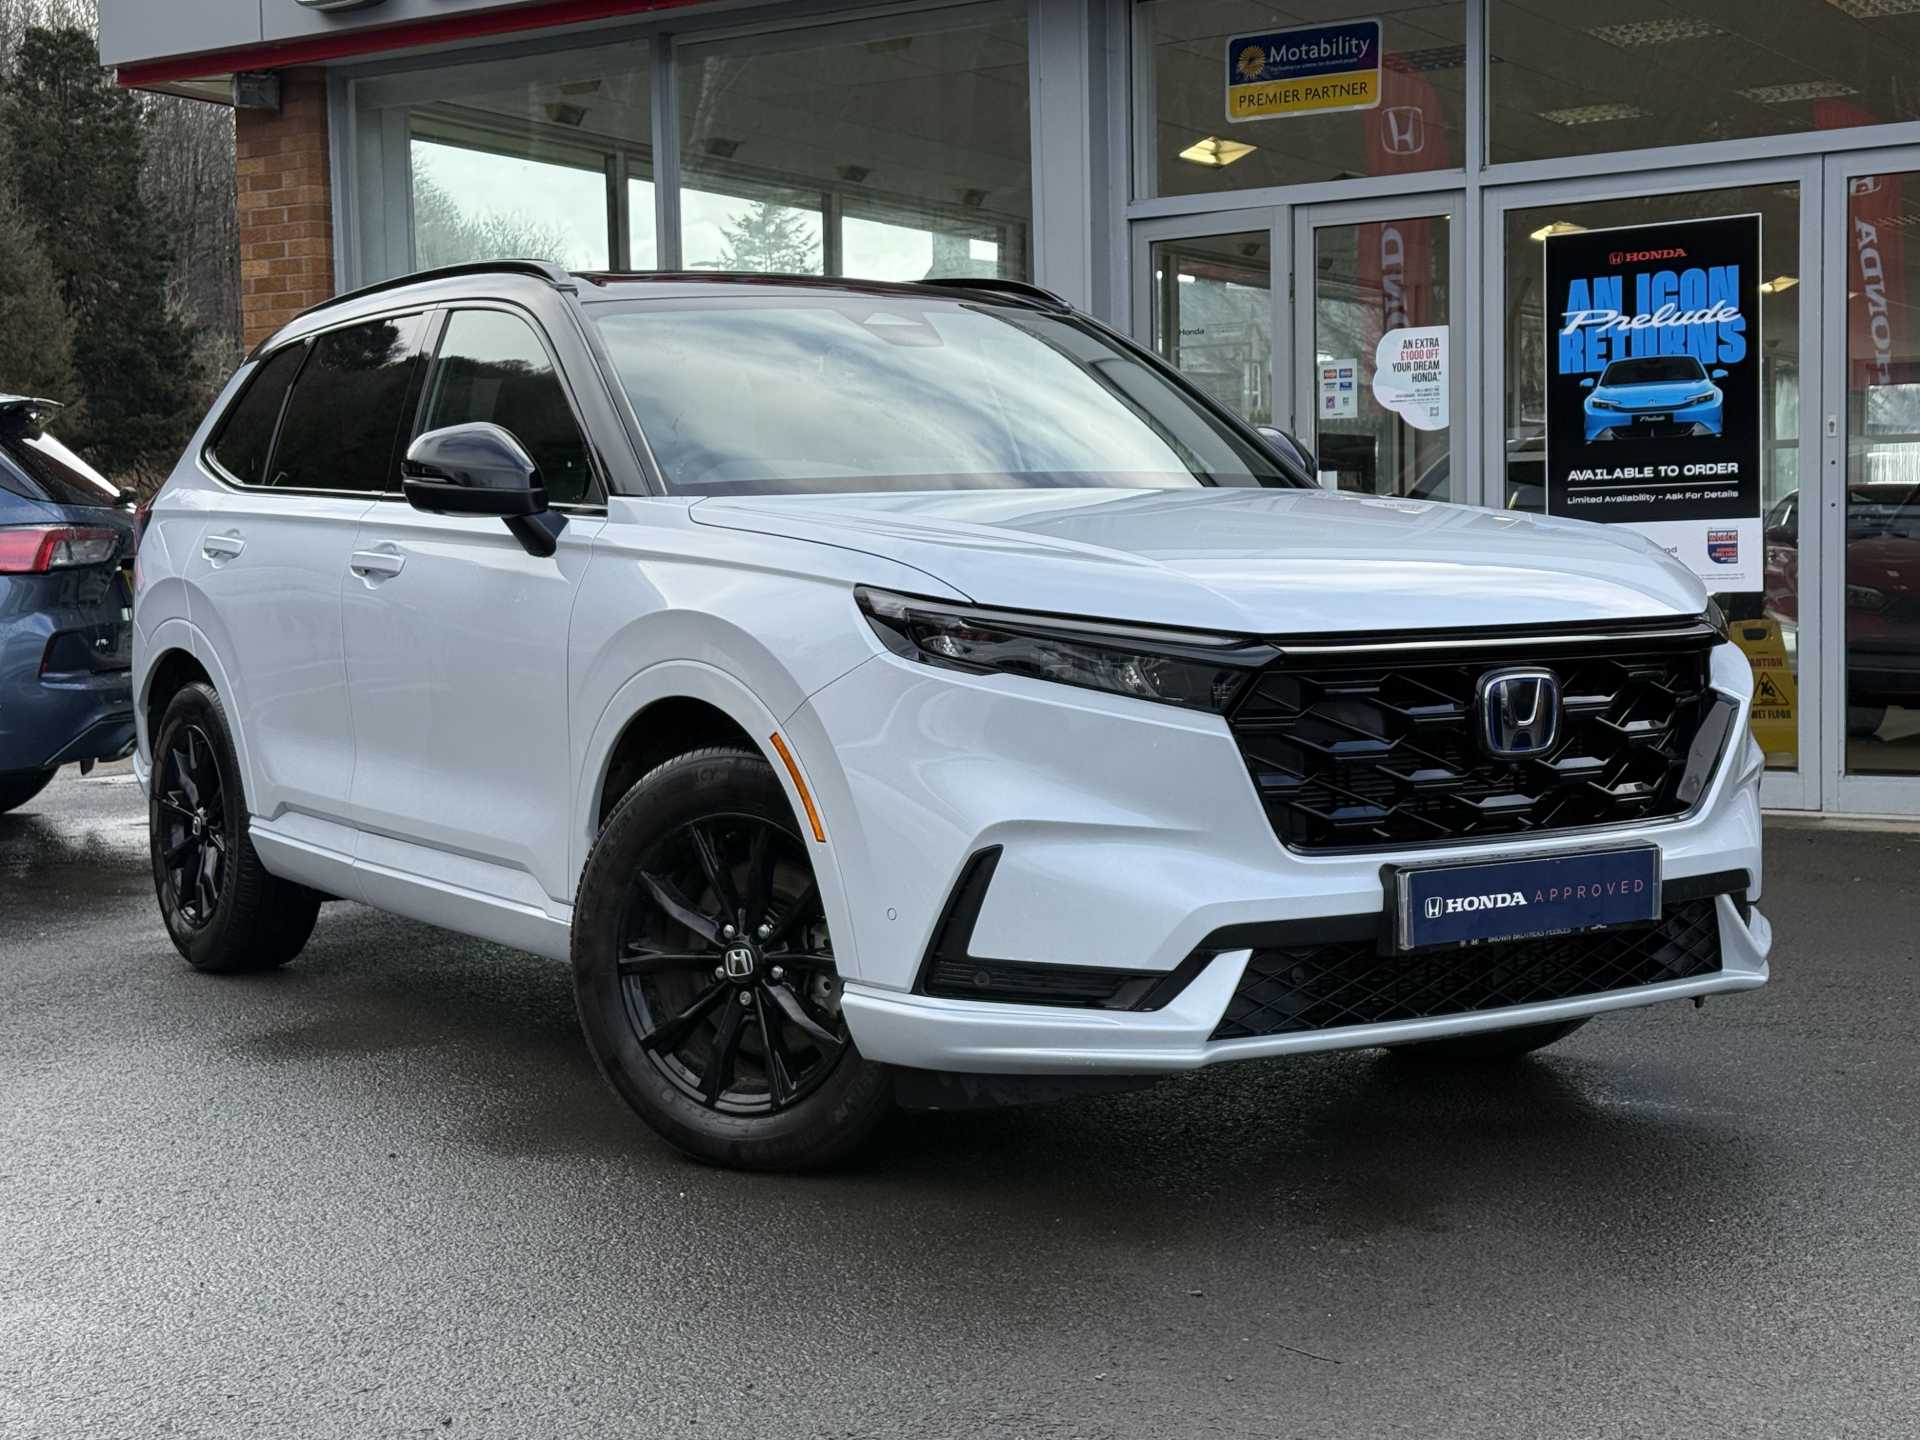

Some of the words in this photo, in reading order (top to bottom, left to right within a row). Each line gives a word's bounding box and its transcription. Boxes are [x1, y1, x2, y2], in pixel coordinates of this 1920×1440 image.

[1269, 36, 1371, 64] Motability
[1238, 88, 1301, 109] PREMIER
[1305, 81, 1369, 100] PARTNER
[1625, 247, 1687, 262] HONDA
[1565, 275, 1623, 327] AN
[1635, 264, 1740, 318] ICON
[1561, 300, 1742, 335] Prelude
[1400, 349, 1424, 361] £1000
[1425, 348, 1439, 359] OFF
[1402, 339, 1413, 349] AN
[1414, 337, 1439, 349] EXTRA
[1558, 316, 1747, 375] RETURNS
[1392, 361, 1412, 373] YOUR
[1413, 360, 1440, 371] DREAM
[1567, 466, 1655, 481] AVAILABLE
[1658, 465, 1679, 477] TO
[1683, 462, 1739, 475] ORDER
[1567, 495, 1604, 504] Limited
[1604, 493, 1656, 503] Availability
[1665, 492, 1684, 501] Ask
[1685, 491, 1702, 500] For
[1704, 489, 1739, 499] Details
[1445, 891, 1528, 913] HONDA
[1534, 878, 1645, 903] APPROVED
